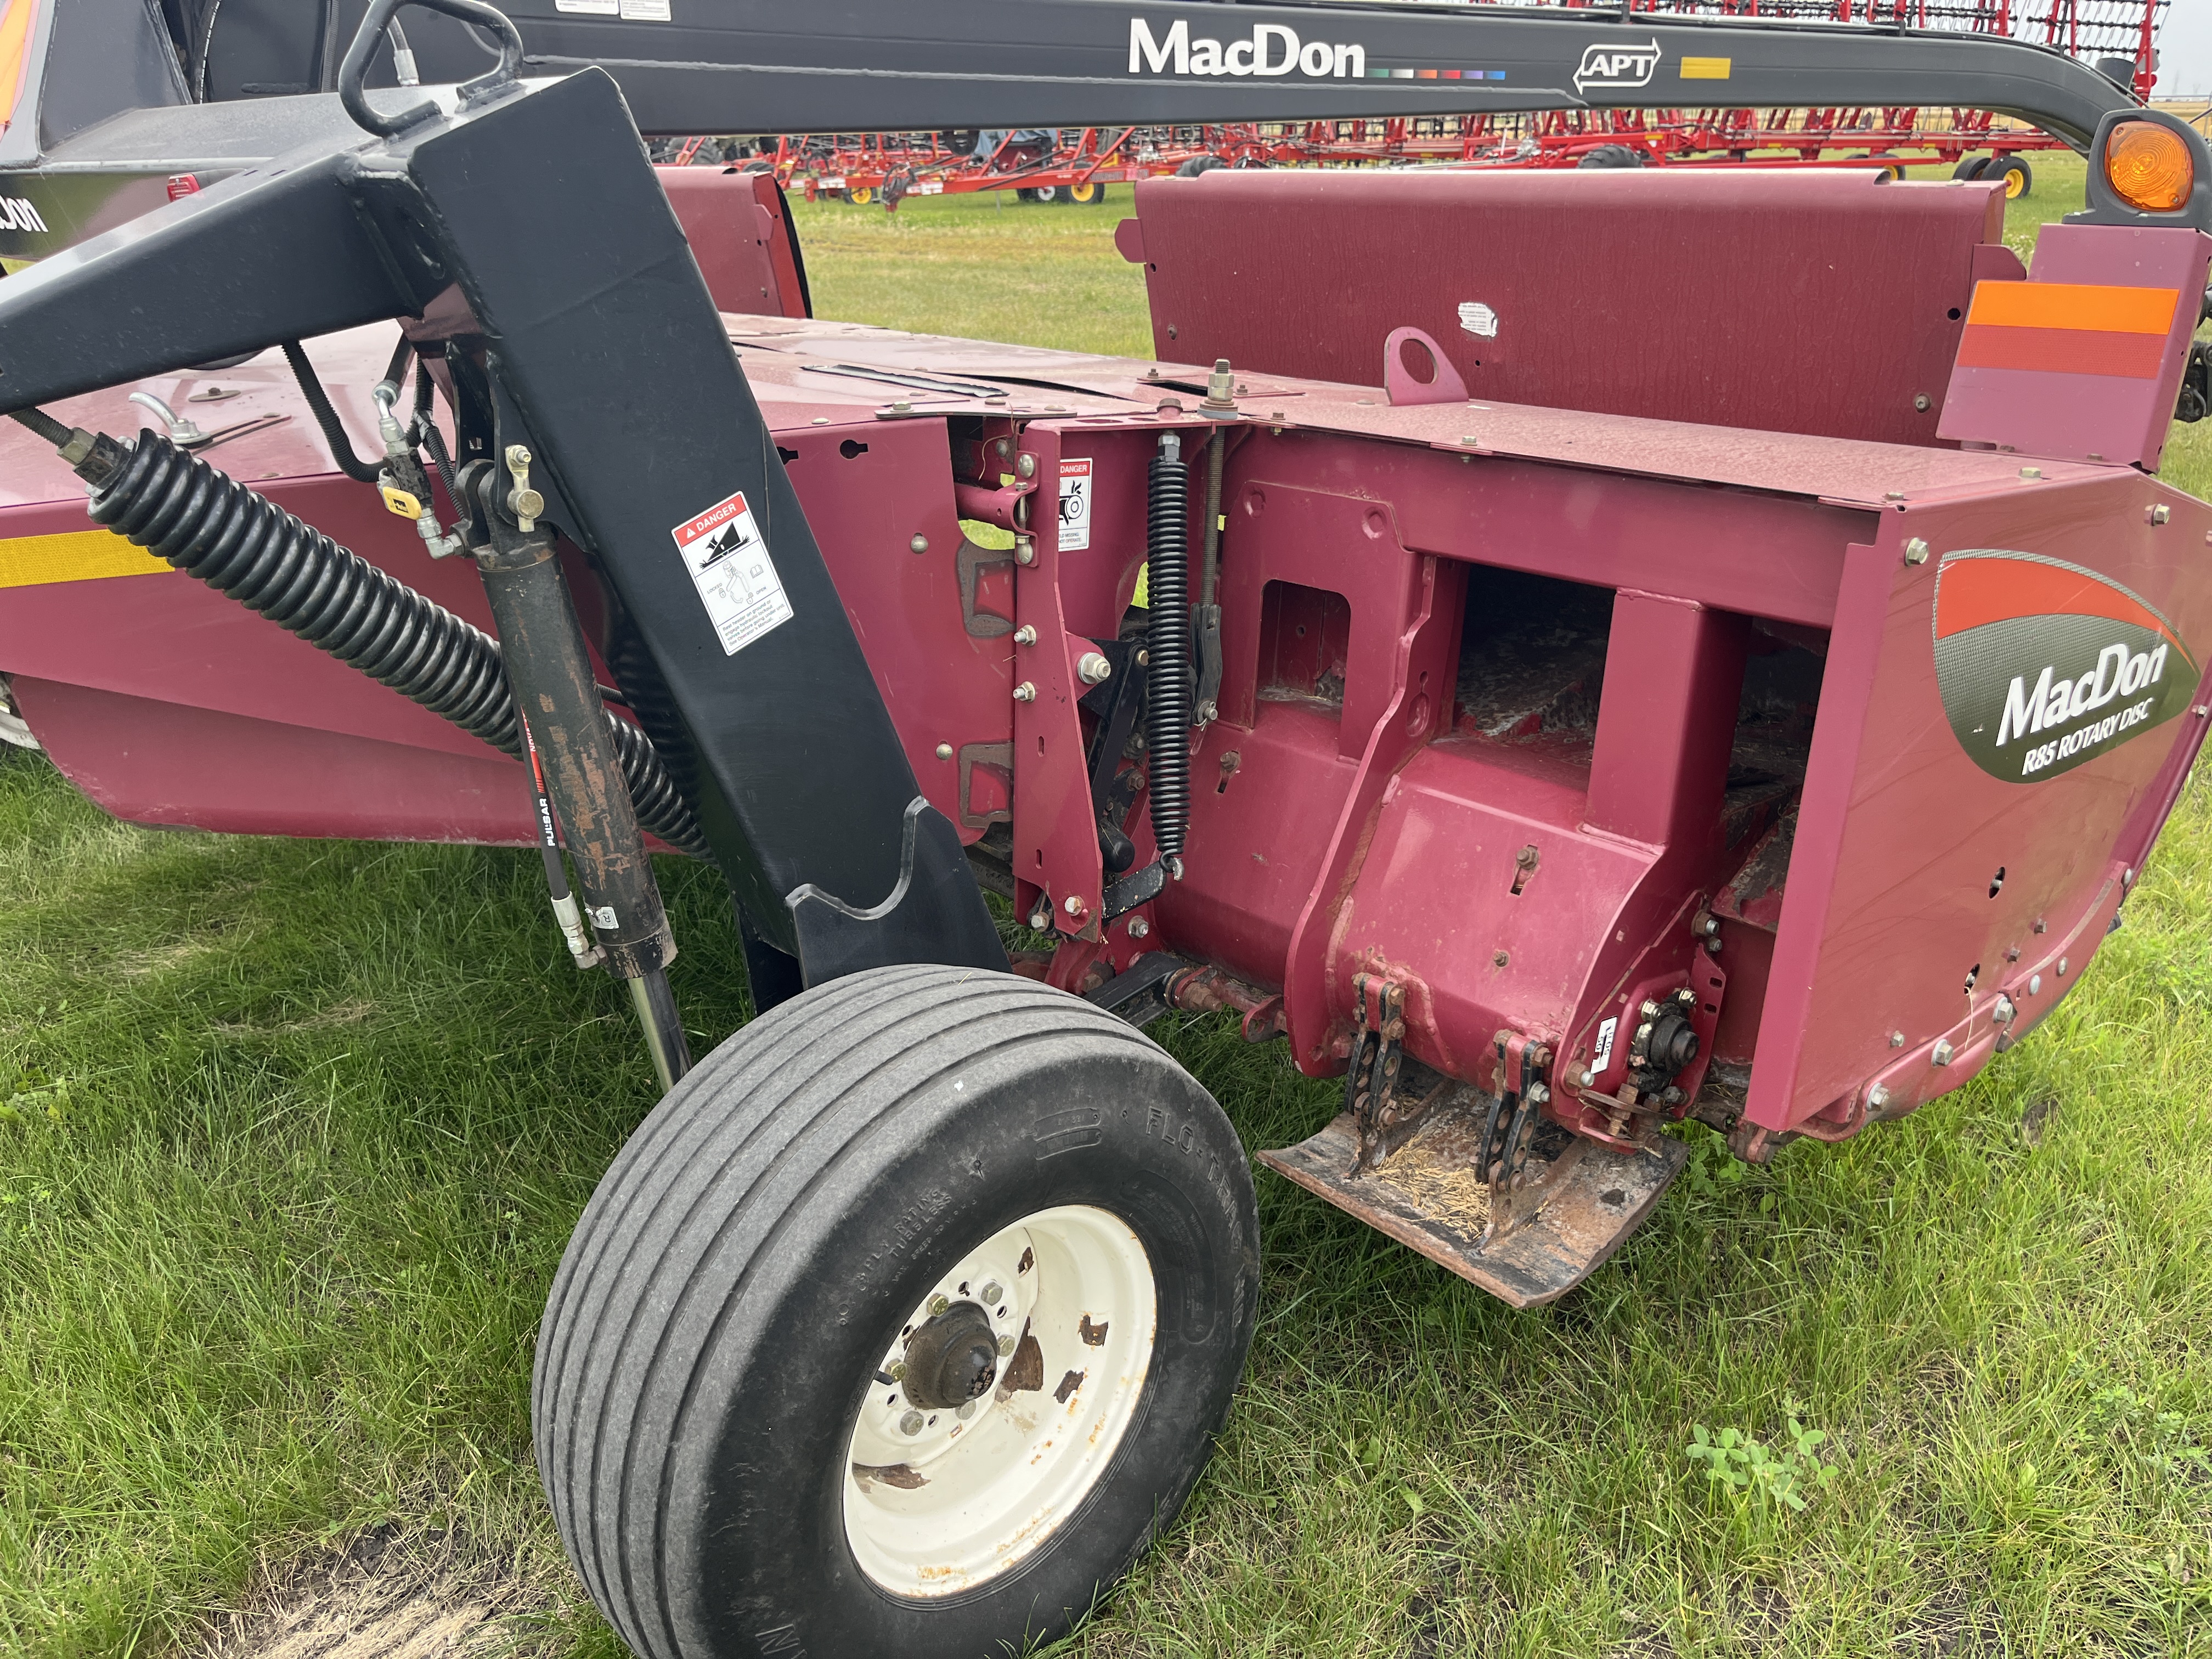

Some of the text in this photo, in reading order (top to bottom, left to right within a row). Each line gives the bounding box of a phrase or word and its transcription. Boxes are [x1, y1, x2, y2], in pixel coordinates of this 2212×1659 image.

[1128, 18, 1365, 77] MacDon
[1581, 54, 1650, 77] APT
[1060, 465, 1087, 473] DANGER
[696, 503, 736, 532] DANGER
[707, 583, 723, 594] LOCKED
[1995, 643, 2168, 747] MacDon
[2022, 698, 2154, 776] R85 ROTARY DISC
[539, 798, 556, 847] PULSAR
